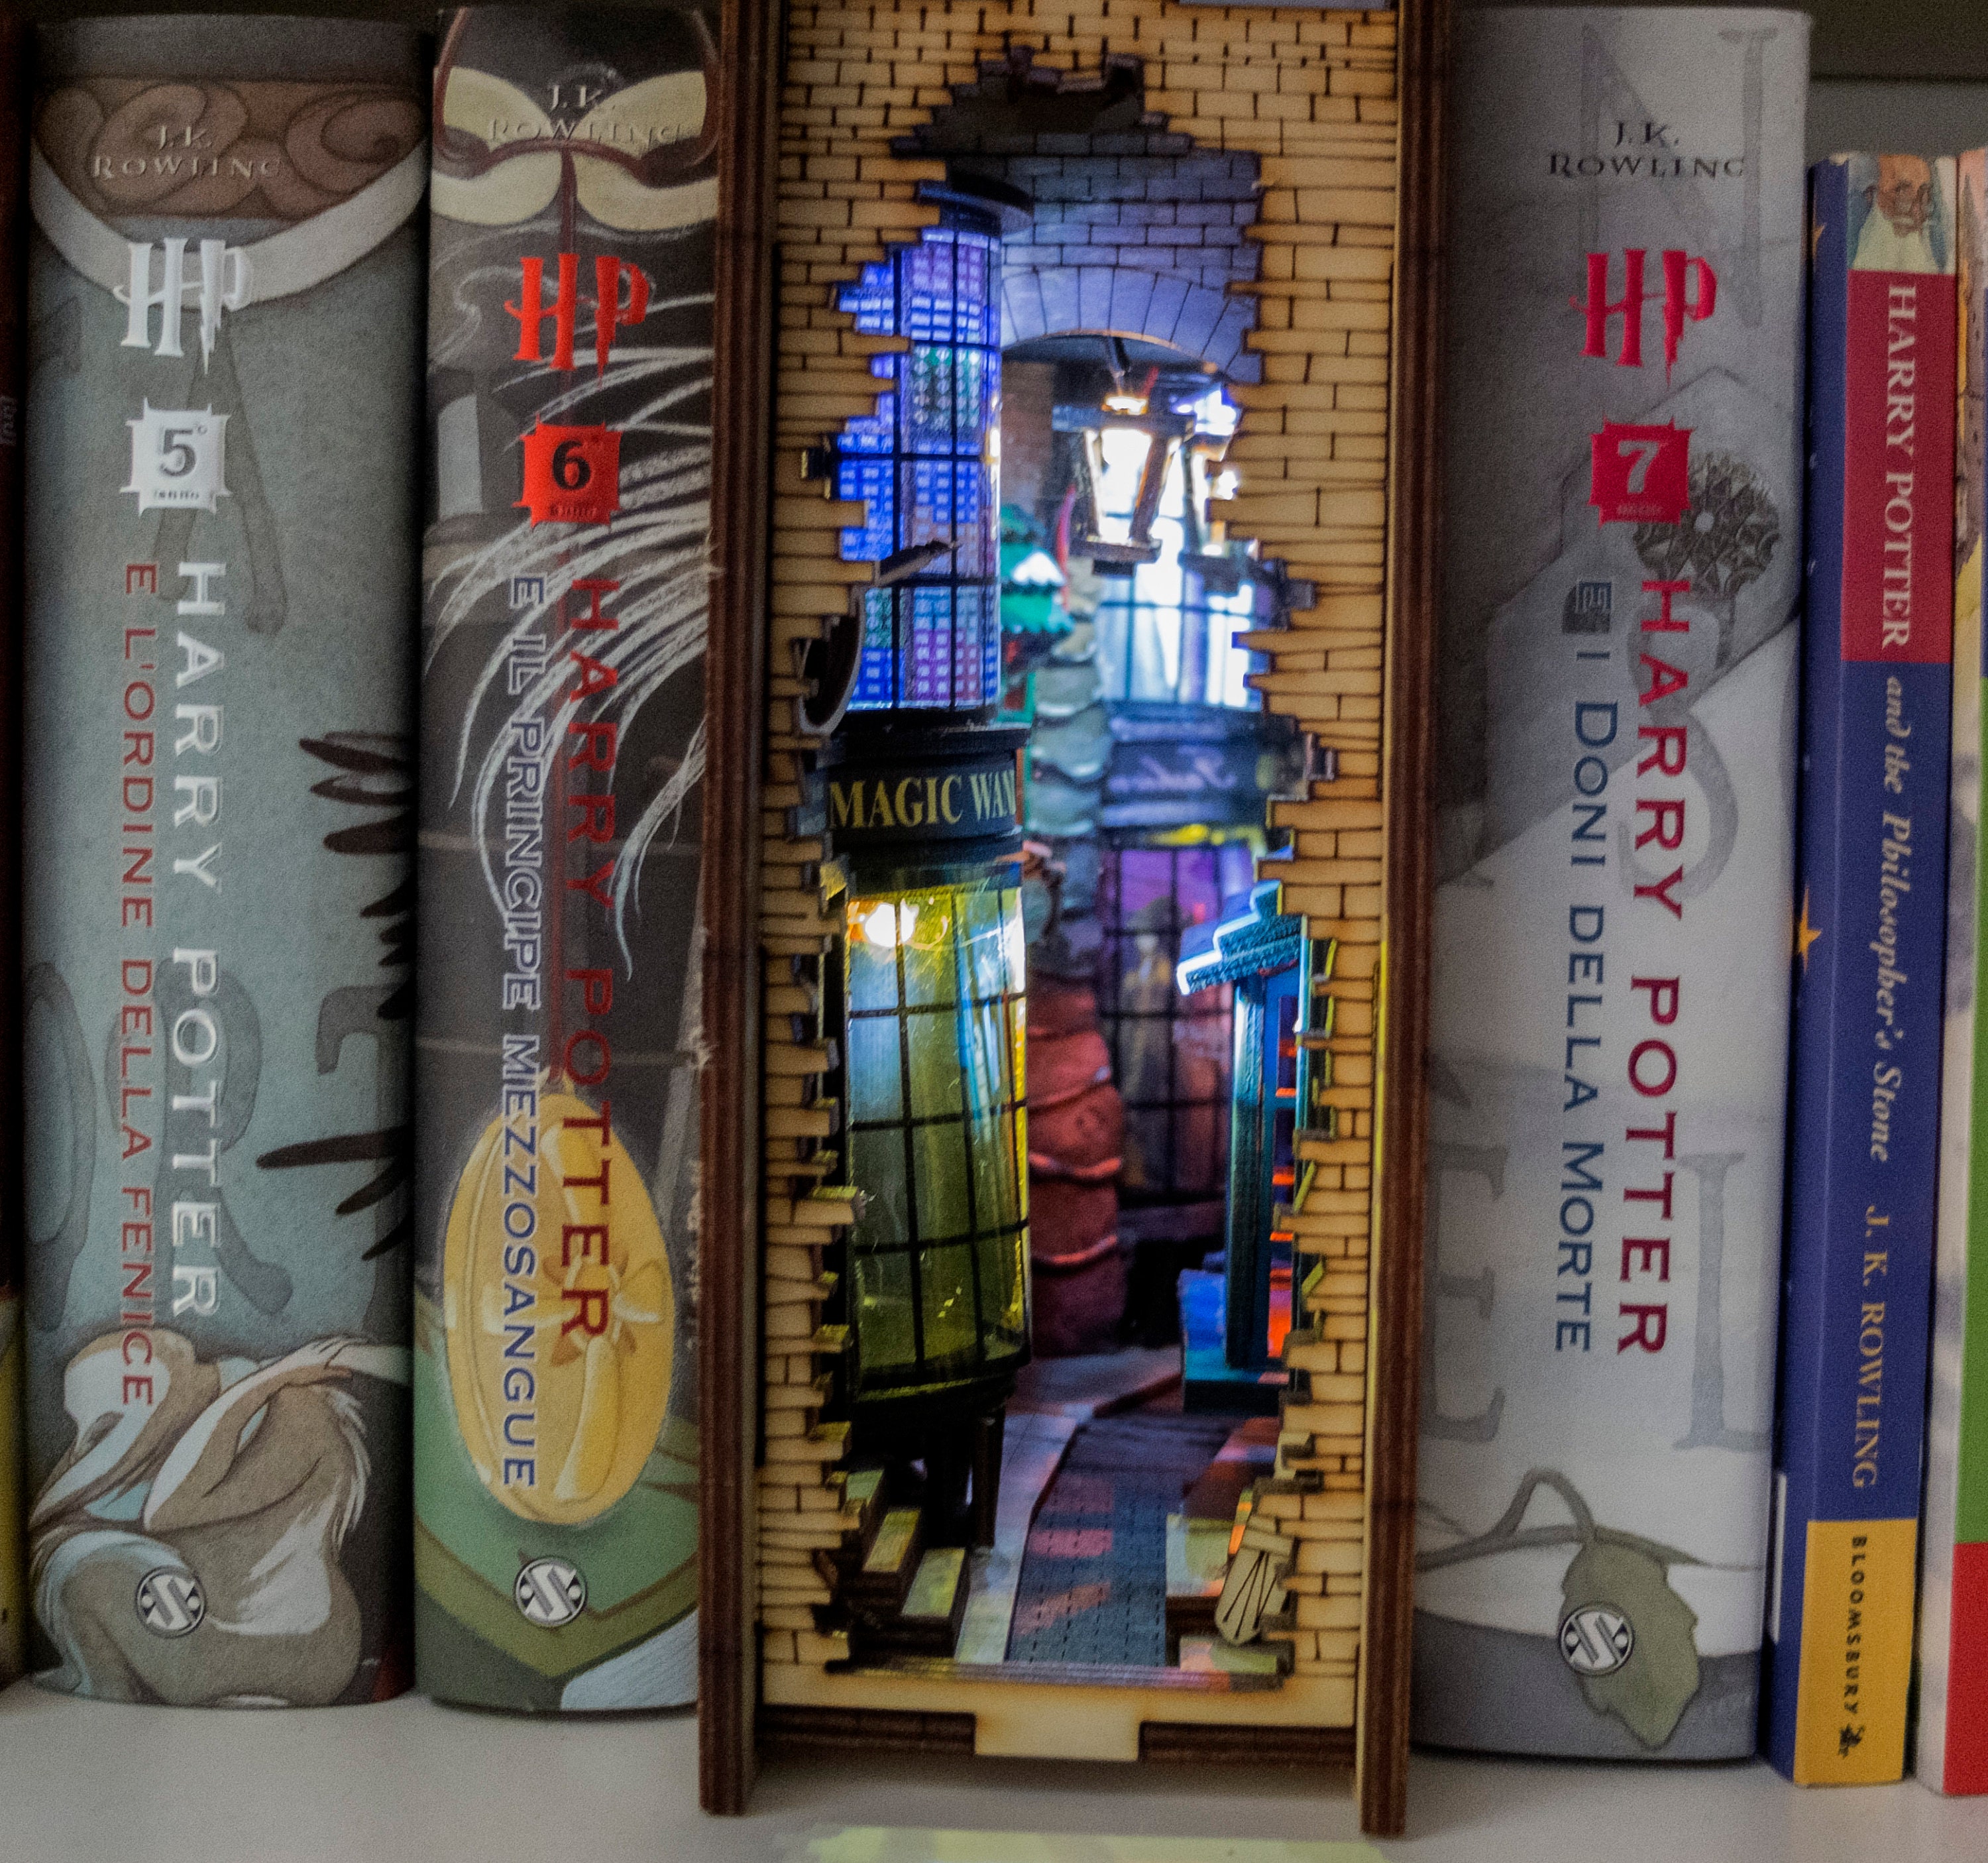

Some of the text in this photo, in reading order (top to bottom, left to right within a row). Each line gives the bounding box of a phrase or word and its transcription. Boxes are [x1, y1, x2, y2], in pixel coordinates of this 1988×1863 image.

[1547, 154, 1745, 178] ROWLING
[113, 237, 253, 375] HP
[504, 253, 650, 391] HP
[1569, 248, 1718, 388] HP
[1618, 440, 1658, 494] 7
[1881, 286, 1916, 649] HARRY POTTER
[567, 579, 620, 909] HARRY
[1576, 651, 1611, 661] I
[1633, 579, 1691, 920] HARRY
[830, 773, 962, 829] MAGIC
[1571, 701, 1618, 866] DONI
[121, 563, 158, 1404] E L'ORDINE DELLA FENICE
[172, 561, 227, 1319] HARRY POTTER
[1563, 905, 1605, 1113] DELLA
[1869, 676, 1912, 1162] and the Philosopher's Stone
[501, 573, 547, 1487] E IL PRINCIPE MEZZOSANGUE
[560, 969, 614, 1337] POTTER
[1555, 1141, 1604, 1352] MORTE
[1617, 974, 1681, 1355] POTTER
[1852, 1205, 1889, 1489] J. K. ROWLING
[1844, 1535, 1867, 1714] BLOOMSBURY
